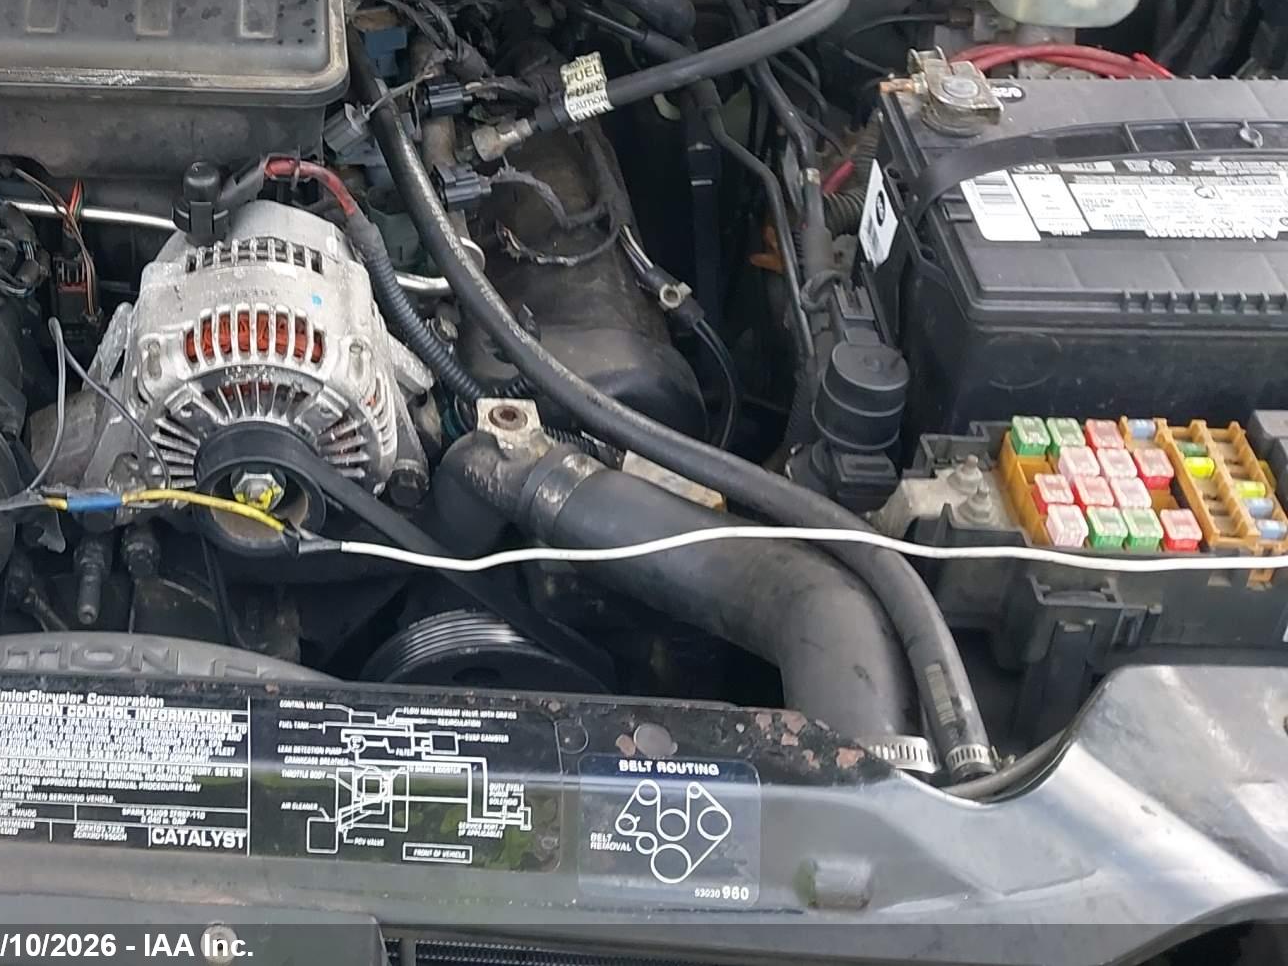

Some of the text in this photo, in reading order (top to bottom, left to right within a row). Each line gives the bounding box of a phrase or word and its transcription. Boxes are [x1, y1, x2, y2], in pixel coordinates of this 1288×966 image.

[87, 692, 164, 708] Corporation
[67, 704, 132, 719] CONTROL
[136, 709, 232, 724] INFORMATION
[619, 759, 719, 775] BELT ROUTING
[281, 802, 291, 810] AIR
[152, 828, 246, 849] CATALYST
[590, 832, 613, 842] BELT
[590, 842, 632, 852] REMOVAL
[722, 886, 749, 900] 960
